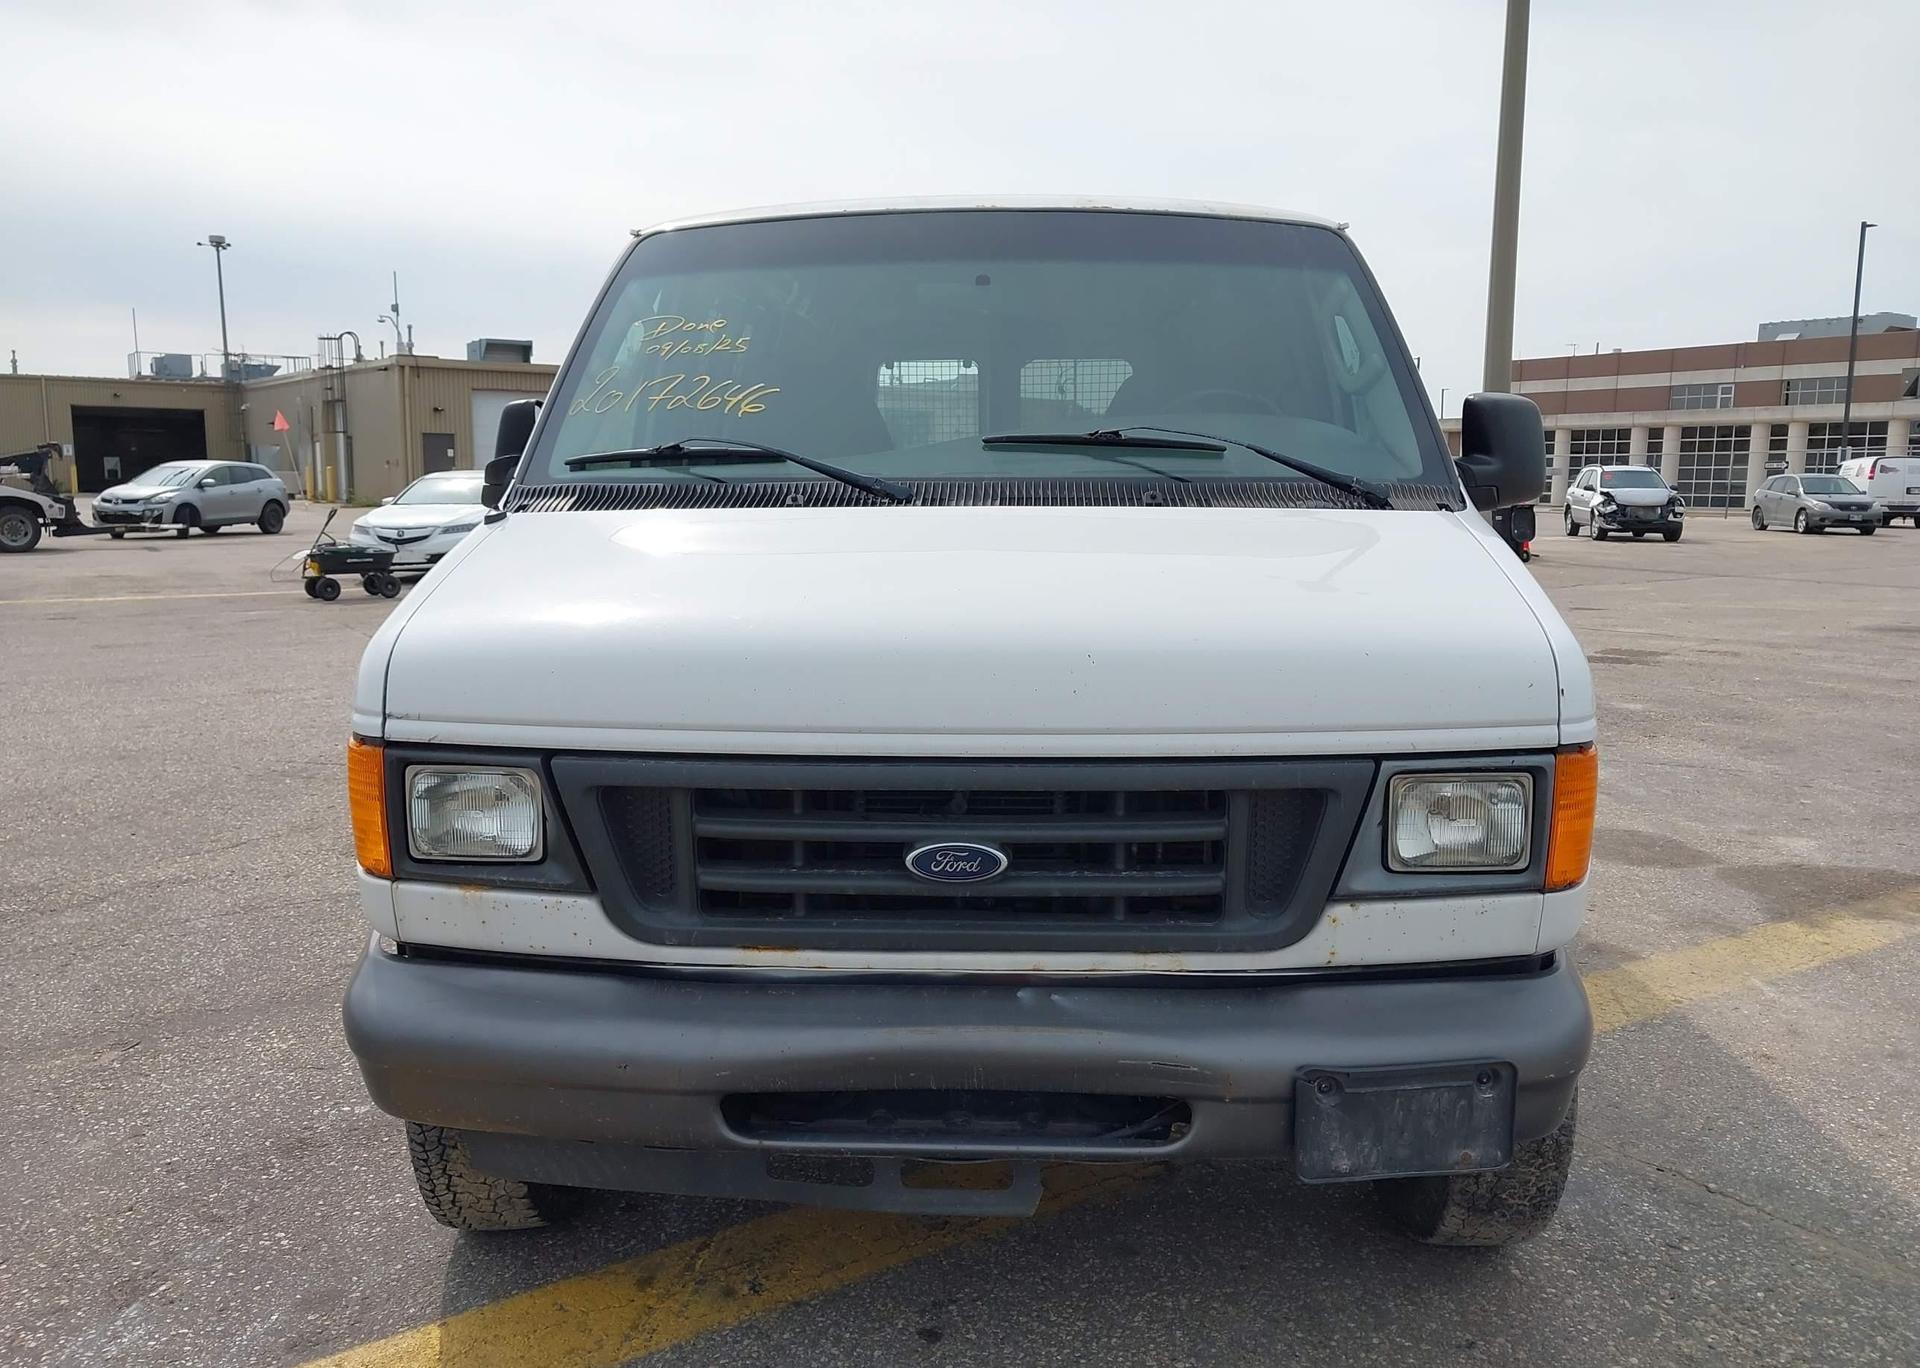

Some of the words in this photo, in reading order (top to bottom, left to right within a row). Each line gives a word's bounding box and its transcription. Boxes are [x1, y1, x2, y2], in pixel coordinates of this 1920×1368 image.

[635, 315, 727, 341] Done
[569, 366, 780, 417] 20172646
[931, 850, 982, 872] Ford
